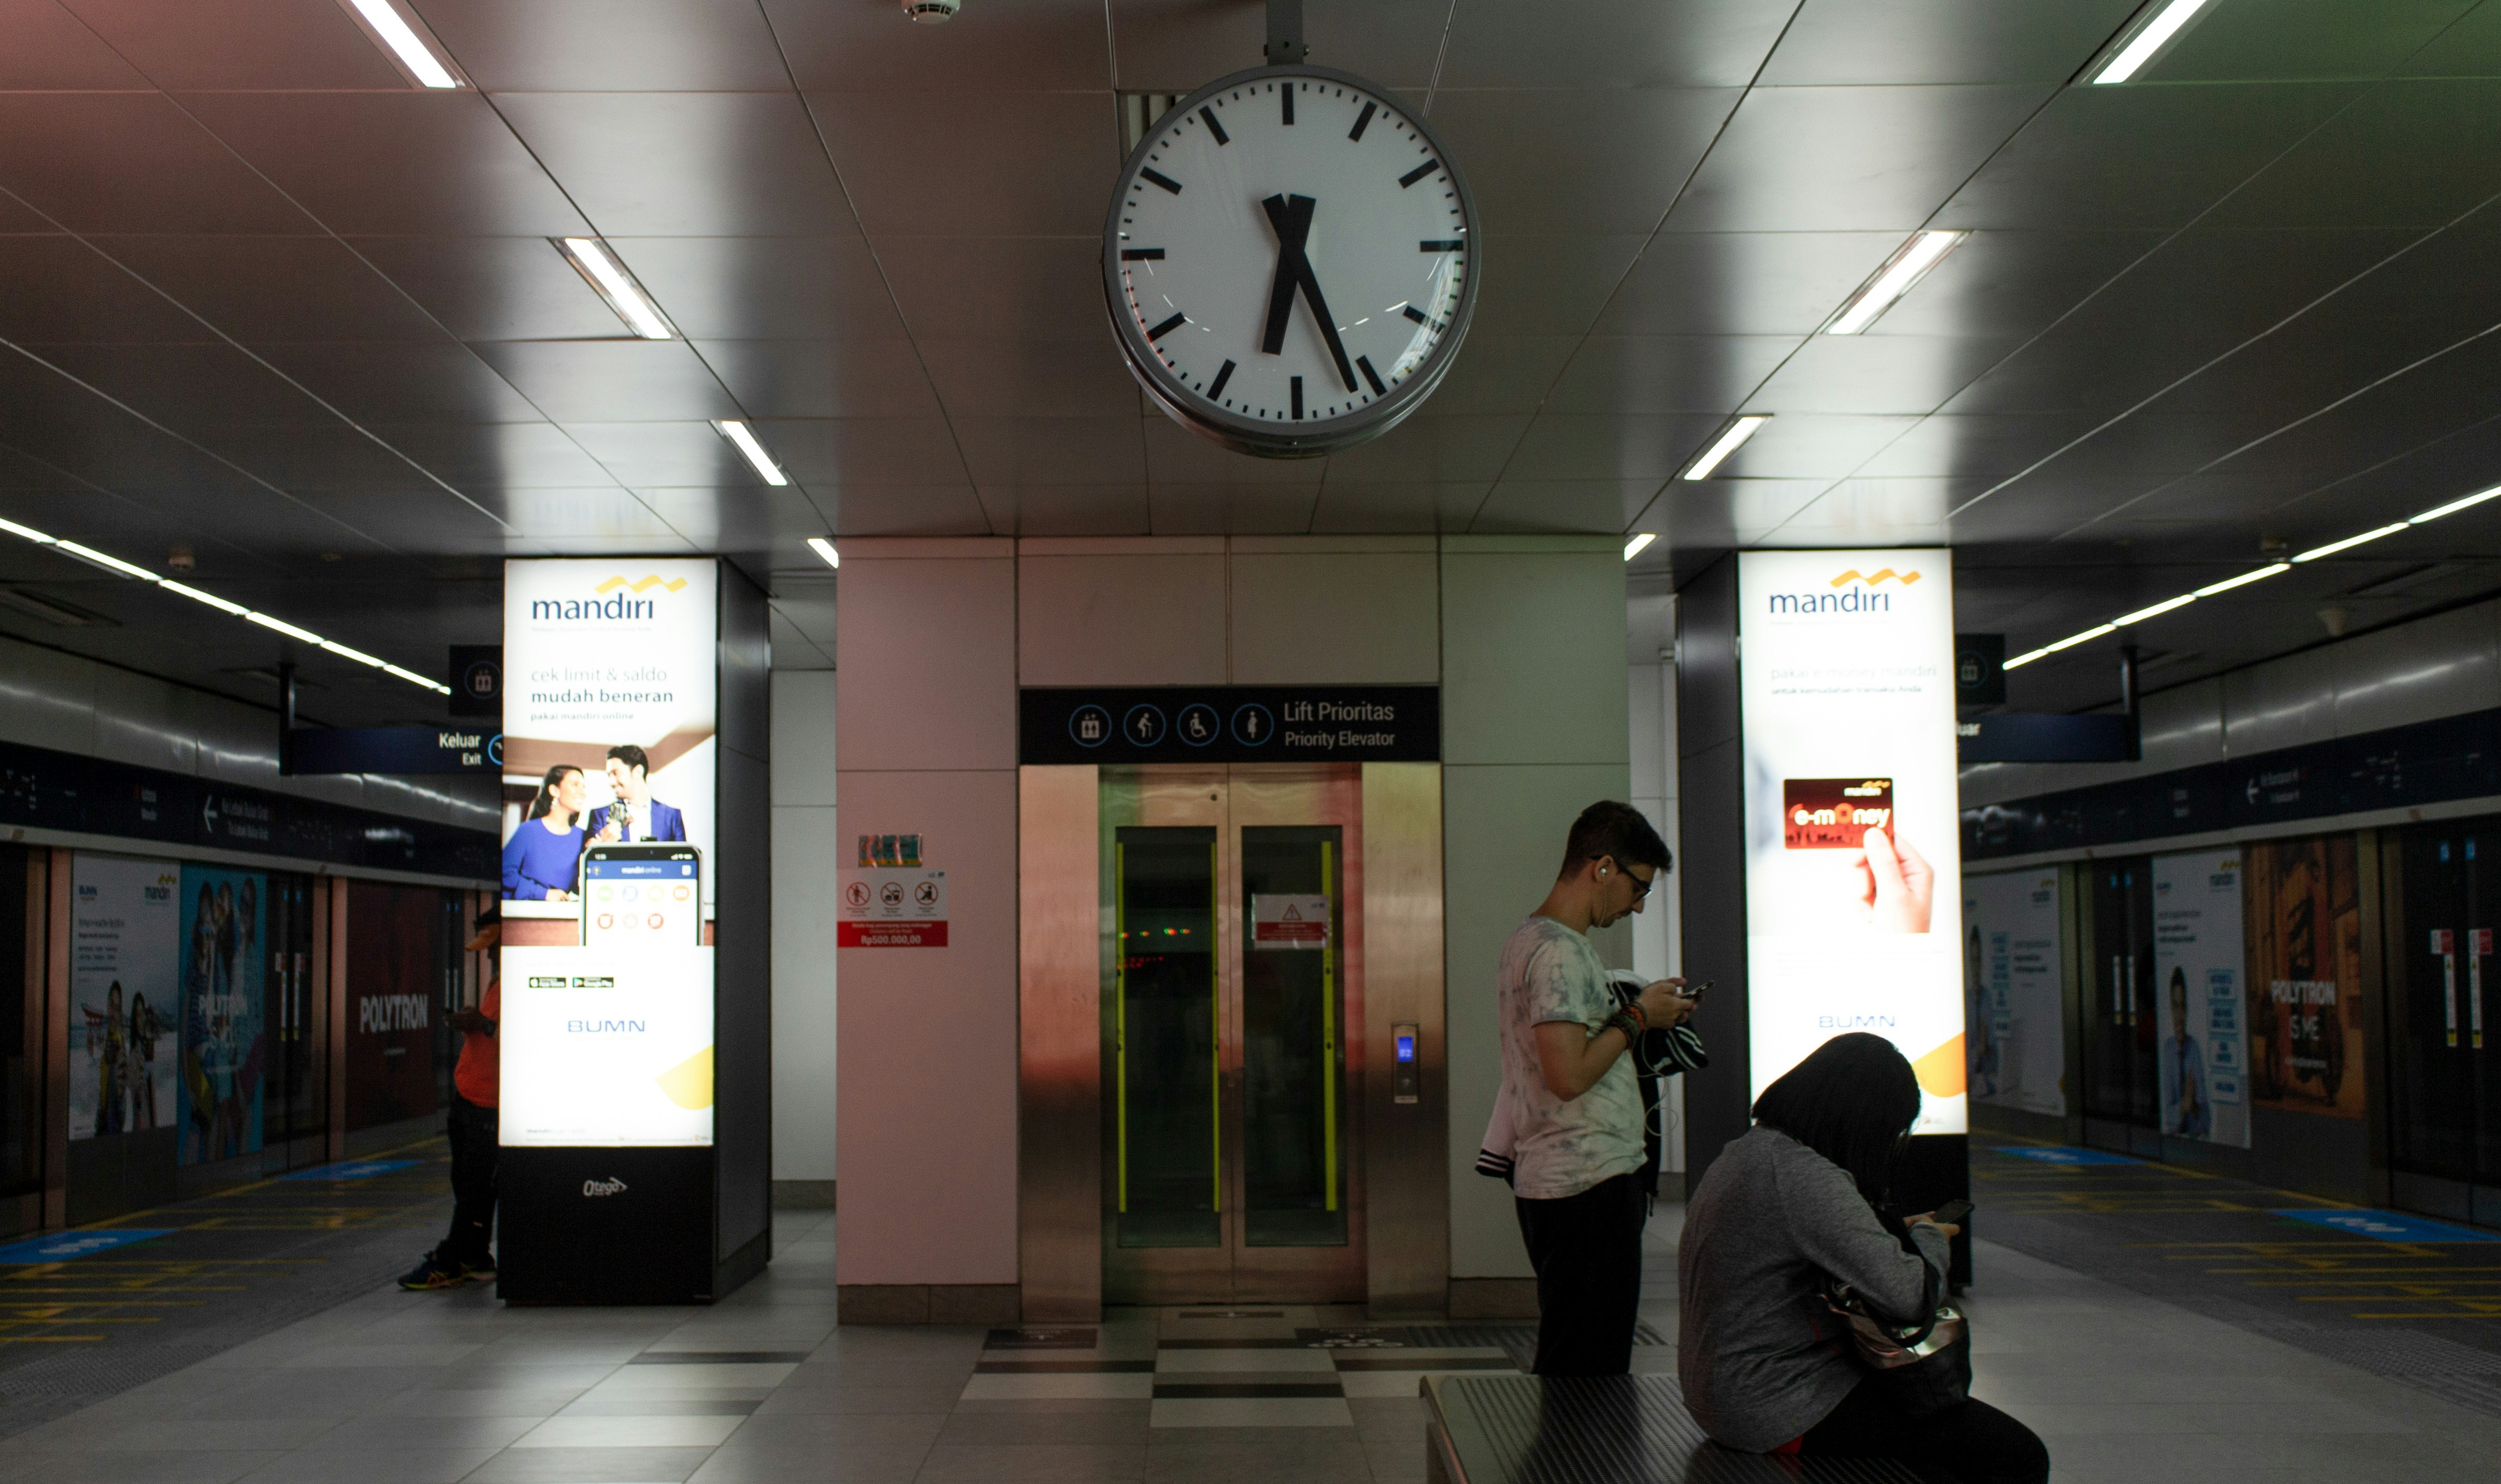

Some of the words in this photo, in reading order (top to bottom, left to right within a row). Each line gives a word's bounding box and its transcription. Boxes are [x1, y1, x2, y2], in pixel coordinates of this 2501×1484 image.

[532, 592, 654, 620] mandiri
[1770, 586, 1889, 613] mandiri
[531, 666, 559, 682] cek
[564, 666, 601, 682] limit
[606, 667, 618, 682] &
[623, 666, 667, 682] saldo
[531, 688, 593, 703] mudah
[599, 688, 673, 703] beneran
[531, 712, 559, 722] pakai
[1284, 701, 1314, 722] Lift
[1318, 700, 1394, 721] Prioritas
[1956, 722, 1981, 737] luar
[439, 732, 481, 748] Keluar
[1285, 730, 1335, 750] Priority
[1339, 730, 1396, 746] Elevator
[462, 753, 482, 766] Exit
[2271, 980, 2335, 1005] POLYTRON
[359, 993, 429, 1034] POLYTRON
[1819, 1015, 1895, 1028] BUMN
[568, 1020, 645, 1033] BUMN
